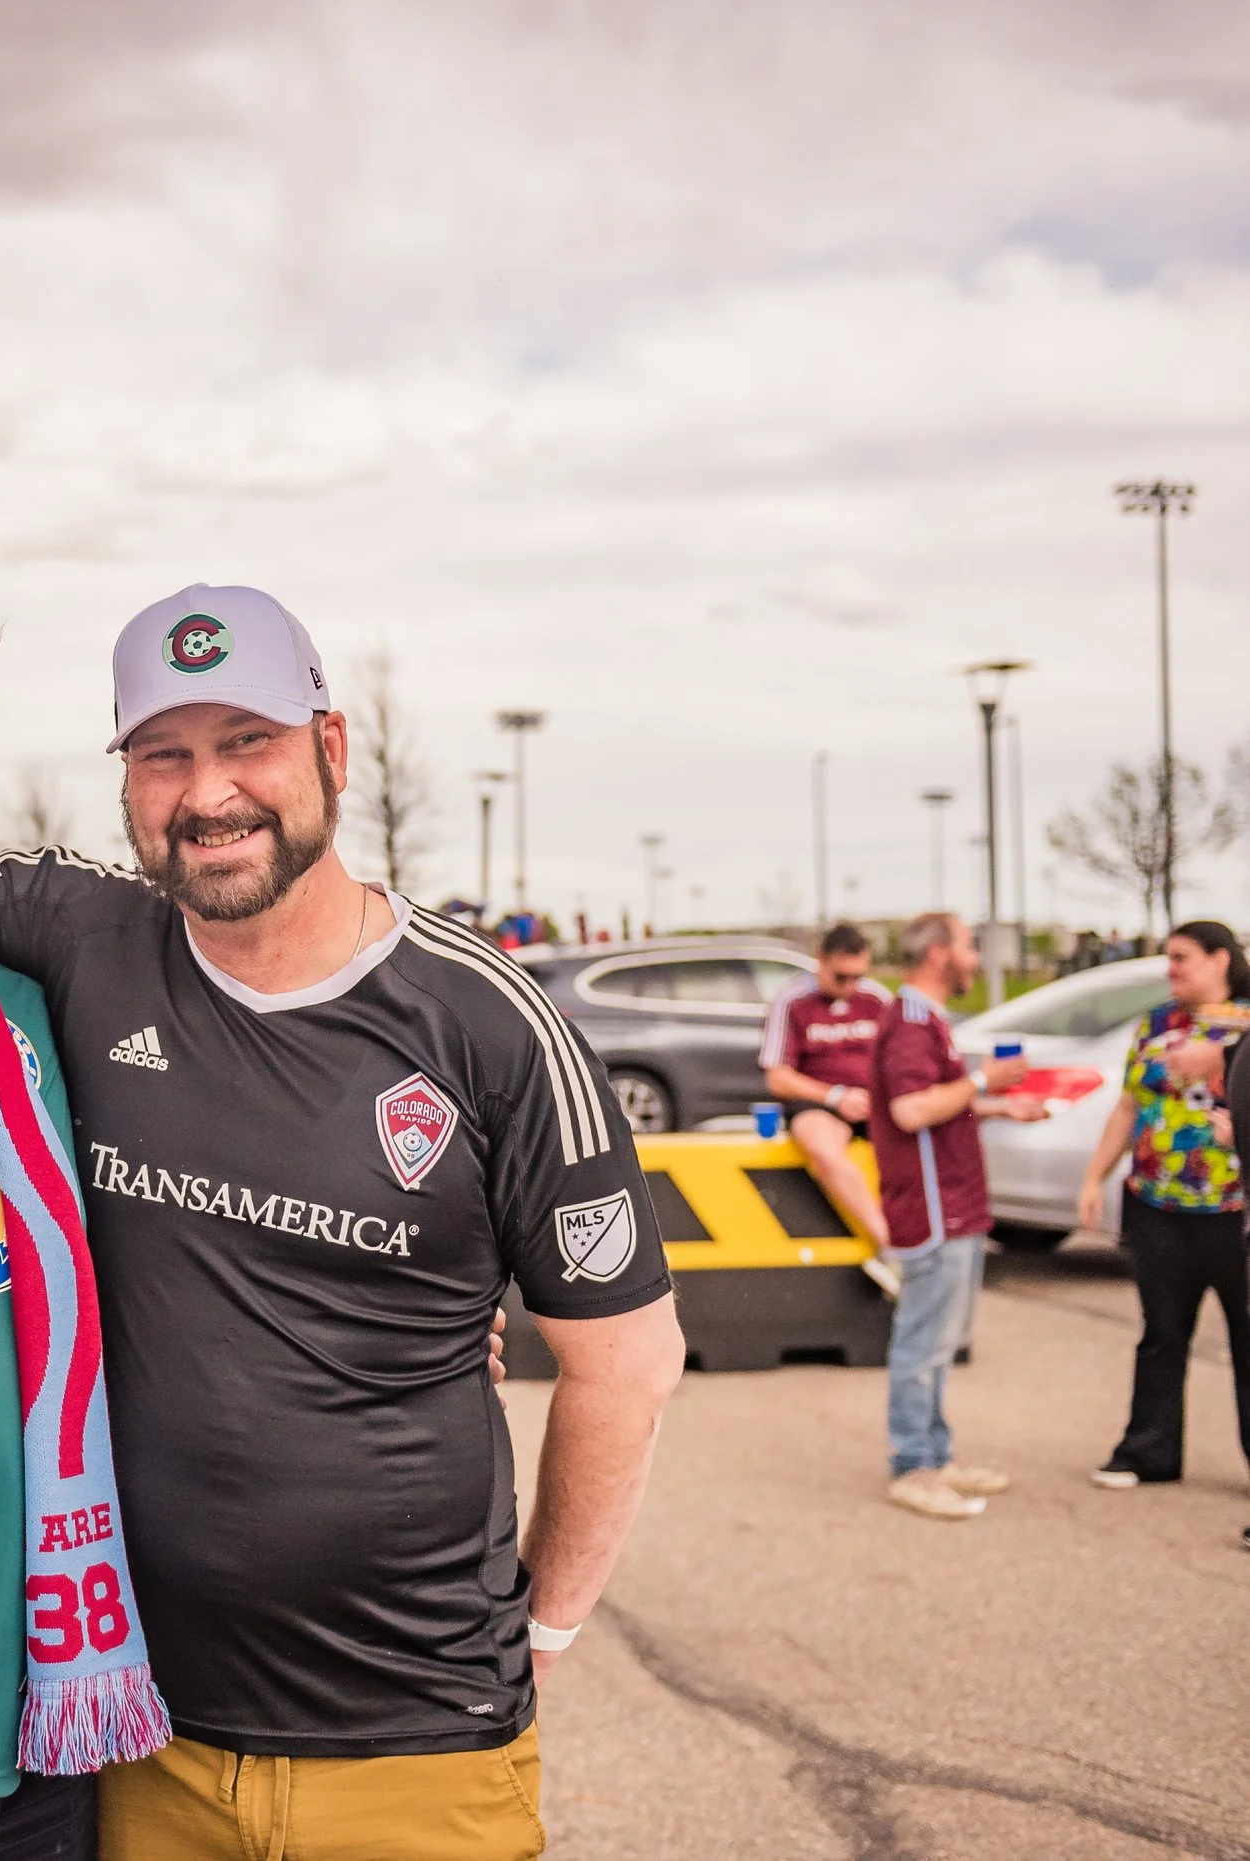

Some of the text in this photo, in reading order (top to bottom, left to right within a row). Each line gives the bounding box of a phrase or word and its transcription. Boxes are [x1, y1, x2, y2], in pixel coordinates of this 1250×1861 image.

[109, 1047, 169, 1071] adidas
[390, 1100, 443, 1125] COLORADO
[400, 1114, 431, 1126] RAPIDS
[566, 1210, 604, 1231] MLS
[38, 1502, 114, 1553] ARE
[26, 1561, 131, 1664] 38
